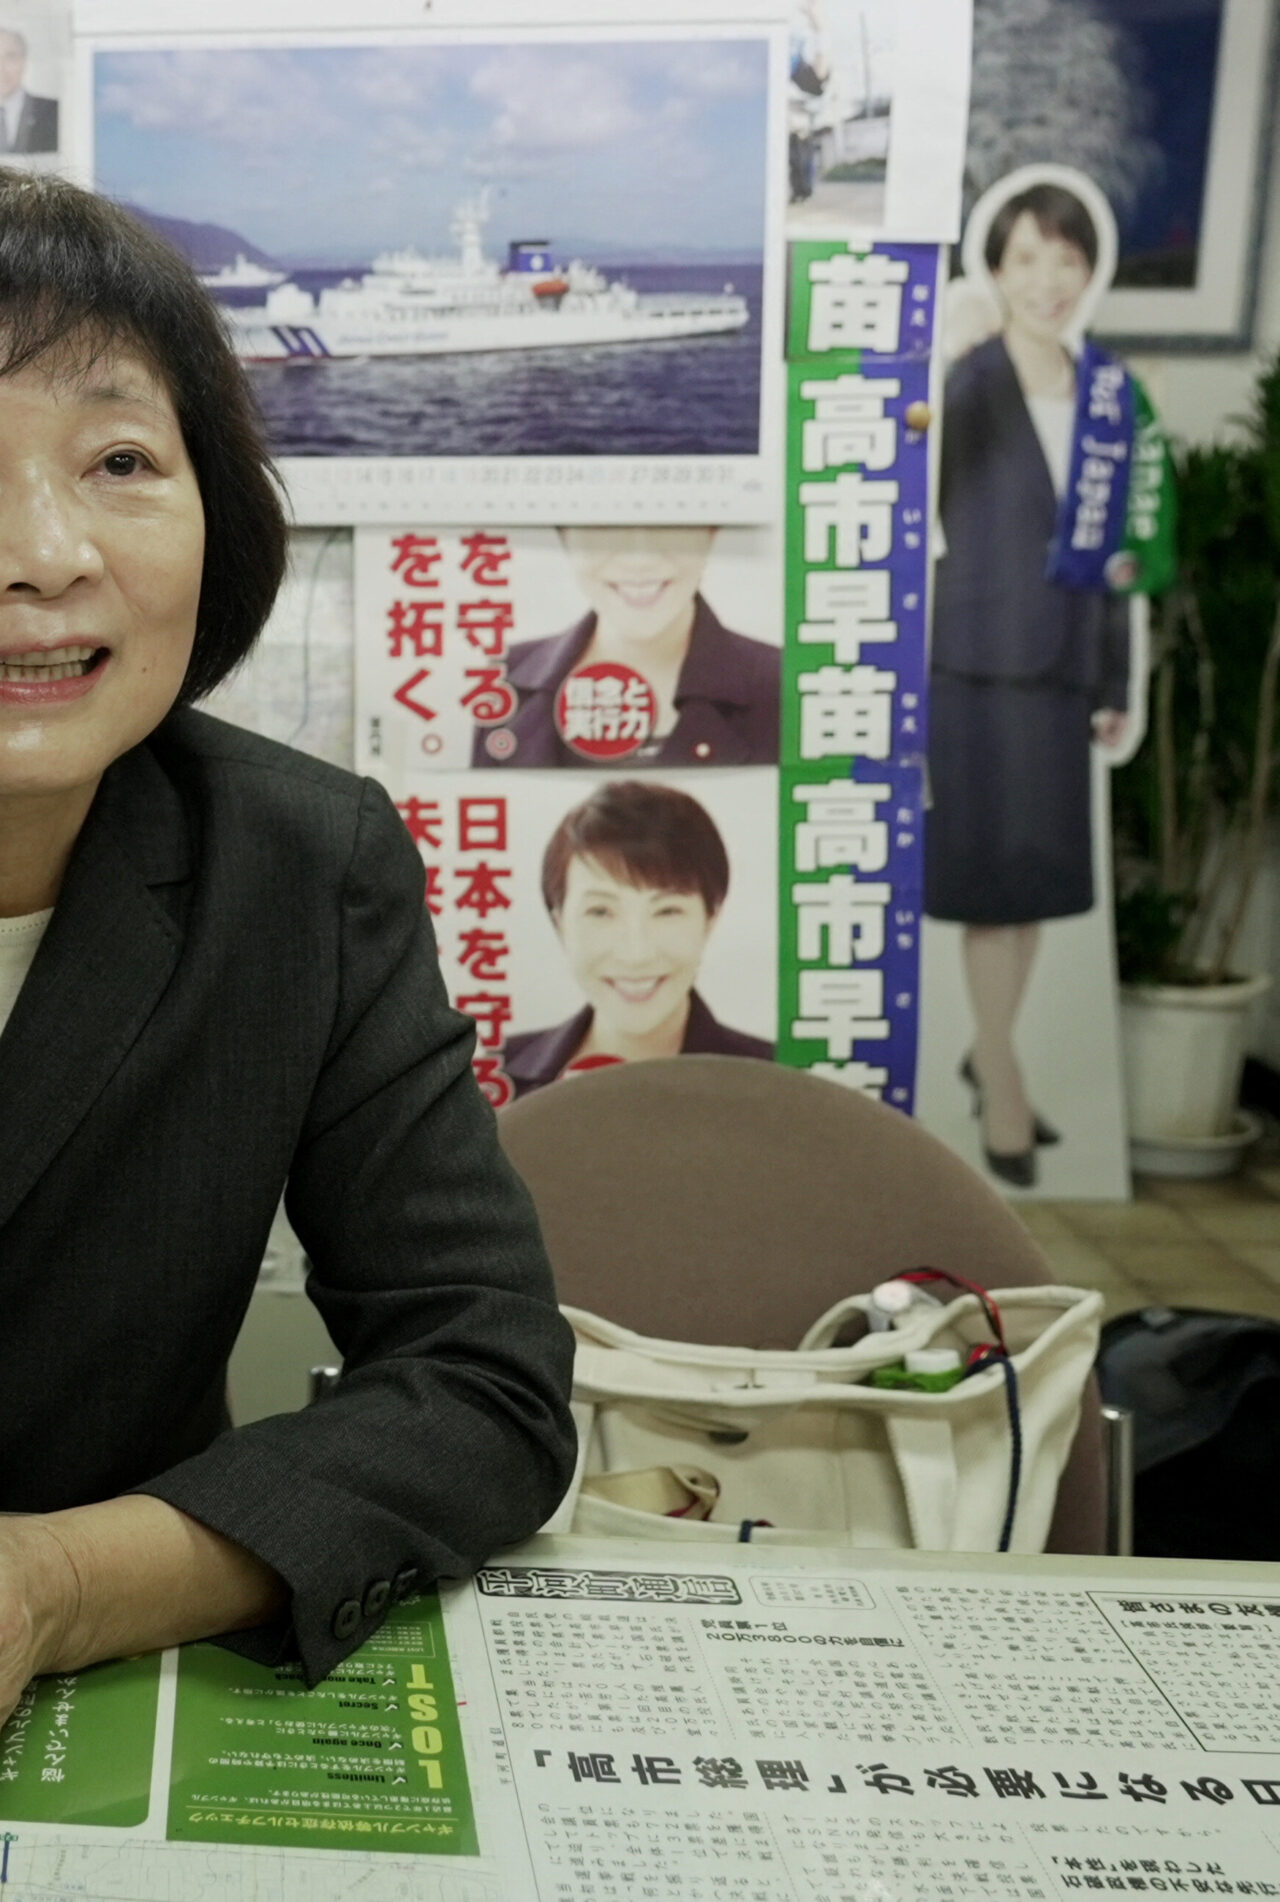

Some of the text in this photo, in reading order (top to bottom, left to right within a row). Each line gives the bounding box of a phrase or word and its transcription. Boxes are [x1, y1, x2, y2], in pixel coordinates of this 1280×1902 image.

[807, 242, 909, 353] 苗
[796, 374, 902, 759] 高市早苗
[387, 533, 443, 755] を拓く。
[456, 533, 519, 761] を守る。
[453, 796, 516, 1108] 日本を守る
[479, 1569, 738, 1602] 平河町通信
[311, 1736, 382, 1749] Once again
[338, 1700, 379, 1711] Secret
[405, 1663, 444, 1789] LOST
[326, 1771, 386, 1784] Limitless
[533, 1748, 1280, 1806] 「高市総理」が必要になる日
[187, 1812, 455, 1837] ギャンブル等依存症セルフチェック
